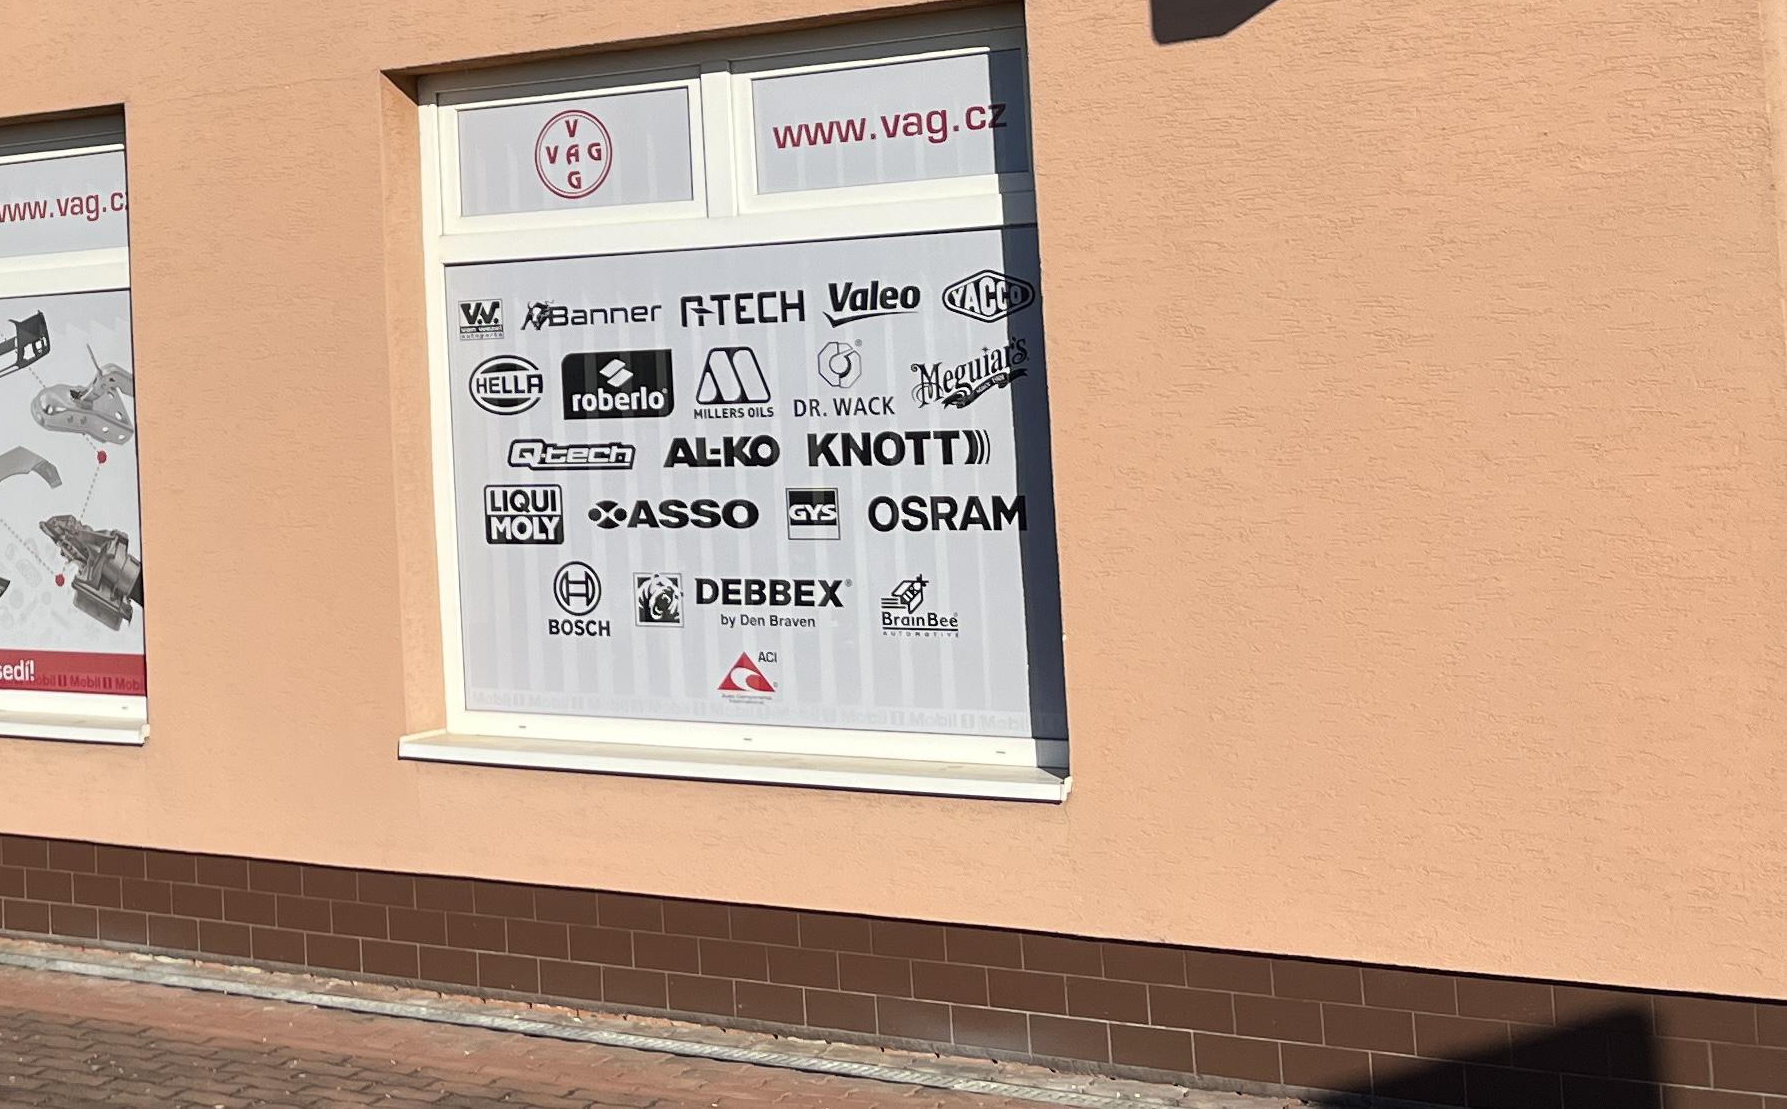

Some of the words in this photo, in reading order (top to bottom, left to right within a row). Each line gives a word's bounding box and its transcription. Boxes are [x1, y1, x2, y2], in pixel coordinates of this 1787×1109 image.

[773, 103, 1008, 150] www.vag.cz
[828, 280, 921, 312] Valeo
[951, 277, 1023, 316] YACCO
[549, 304, 662, 327] Banner
[476, 374, 544, 394] HELLA
[572, 386, 665, 412] roberlo
[793, 399, 827, 418] DR.
[833, 396, 895, 416] WACK
[694, 407, 744, 420] MILLERS
[748, 406, 774, 419] OILS
[663, 434, 781, 468] AL-KO
[490, 489, 557, 513] LIQUI
[627, 498, 759, 529] ASSO
[789, 503, 837, 522] GYS
[868, 495, 1028, 532] OSRAM
[490, 515, 560, 541] MOLY
[695, 577, 844, 607] DEBBEX
[548, 618, 611, 637] BOSCH
[720, 614, 735, 628] by
[740, 614, 765, 627] Den
[769, 615, 816, 628] Braven
[758, 651, 778, 663] ACI
